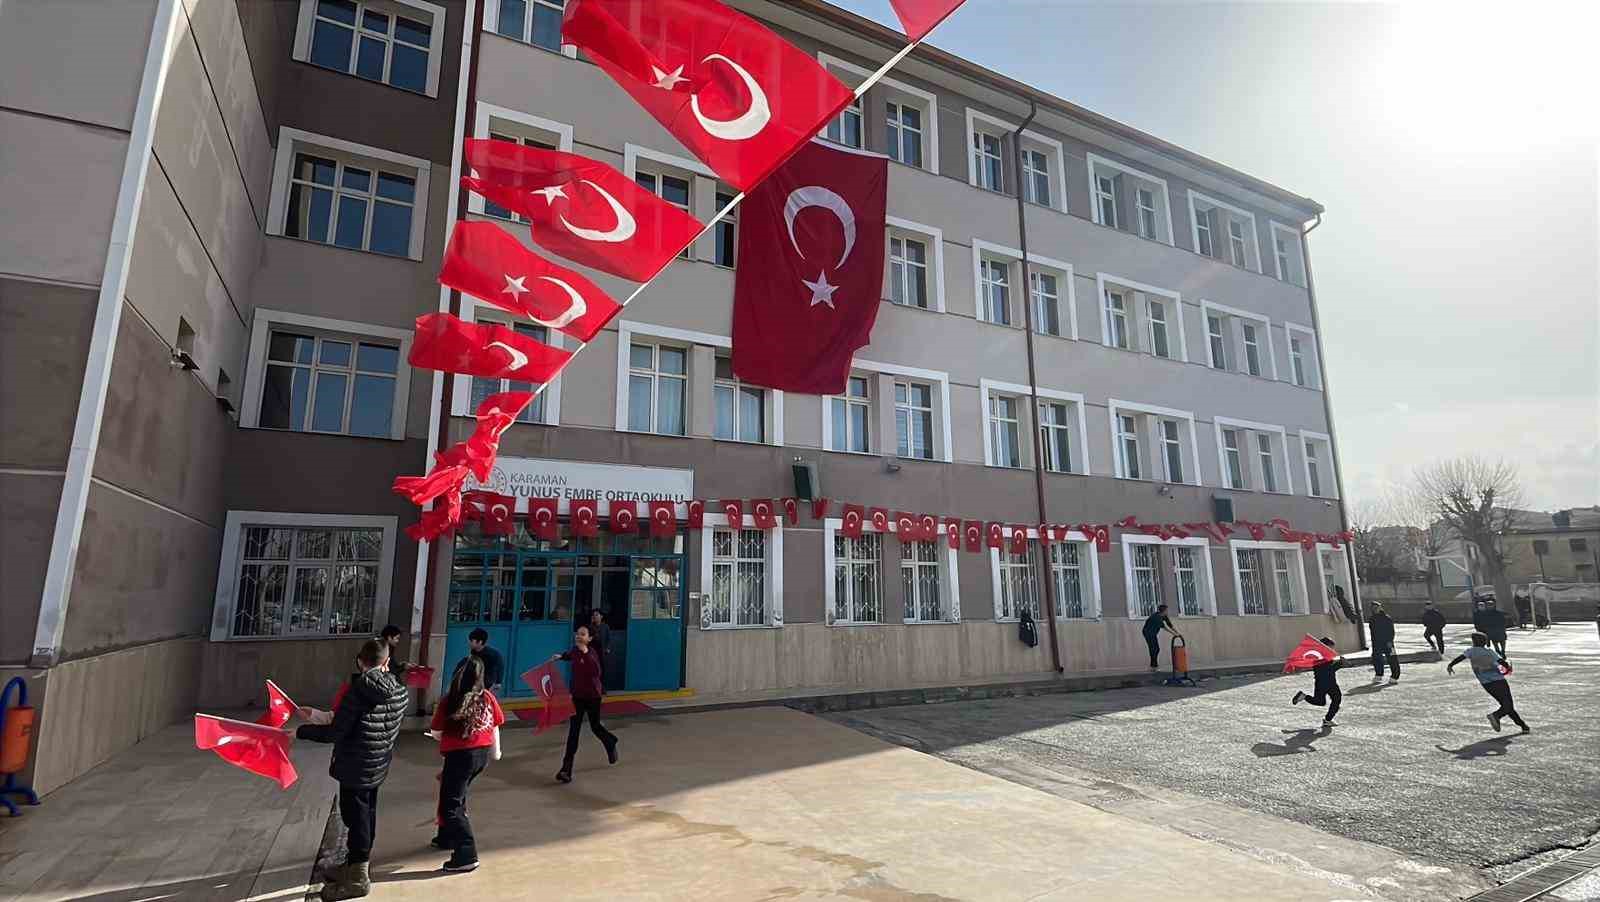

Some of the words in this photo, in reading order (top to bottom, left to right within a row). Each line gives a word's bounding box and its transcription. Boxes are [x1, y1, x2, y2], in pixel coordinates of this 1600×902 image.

[511, 473, 568, 485] KARAMAN
[510, 485, 561, 498] YUNUS
[564, 488, 603, 501] EMRE
